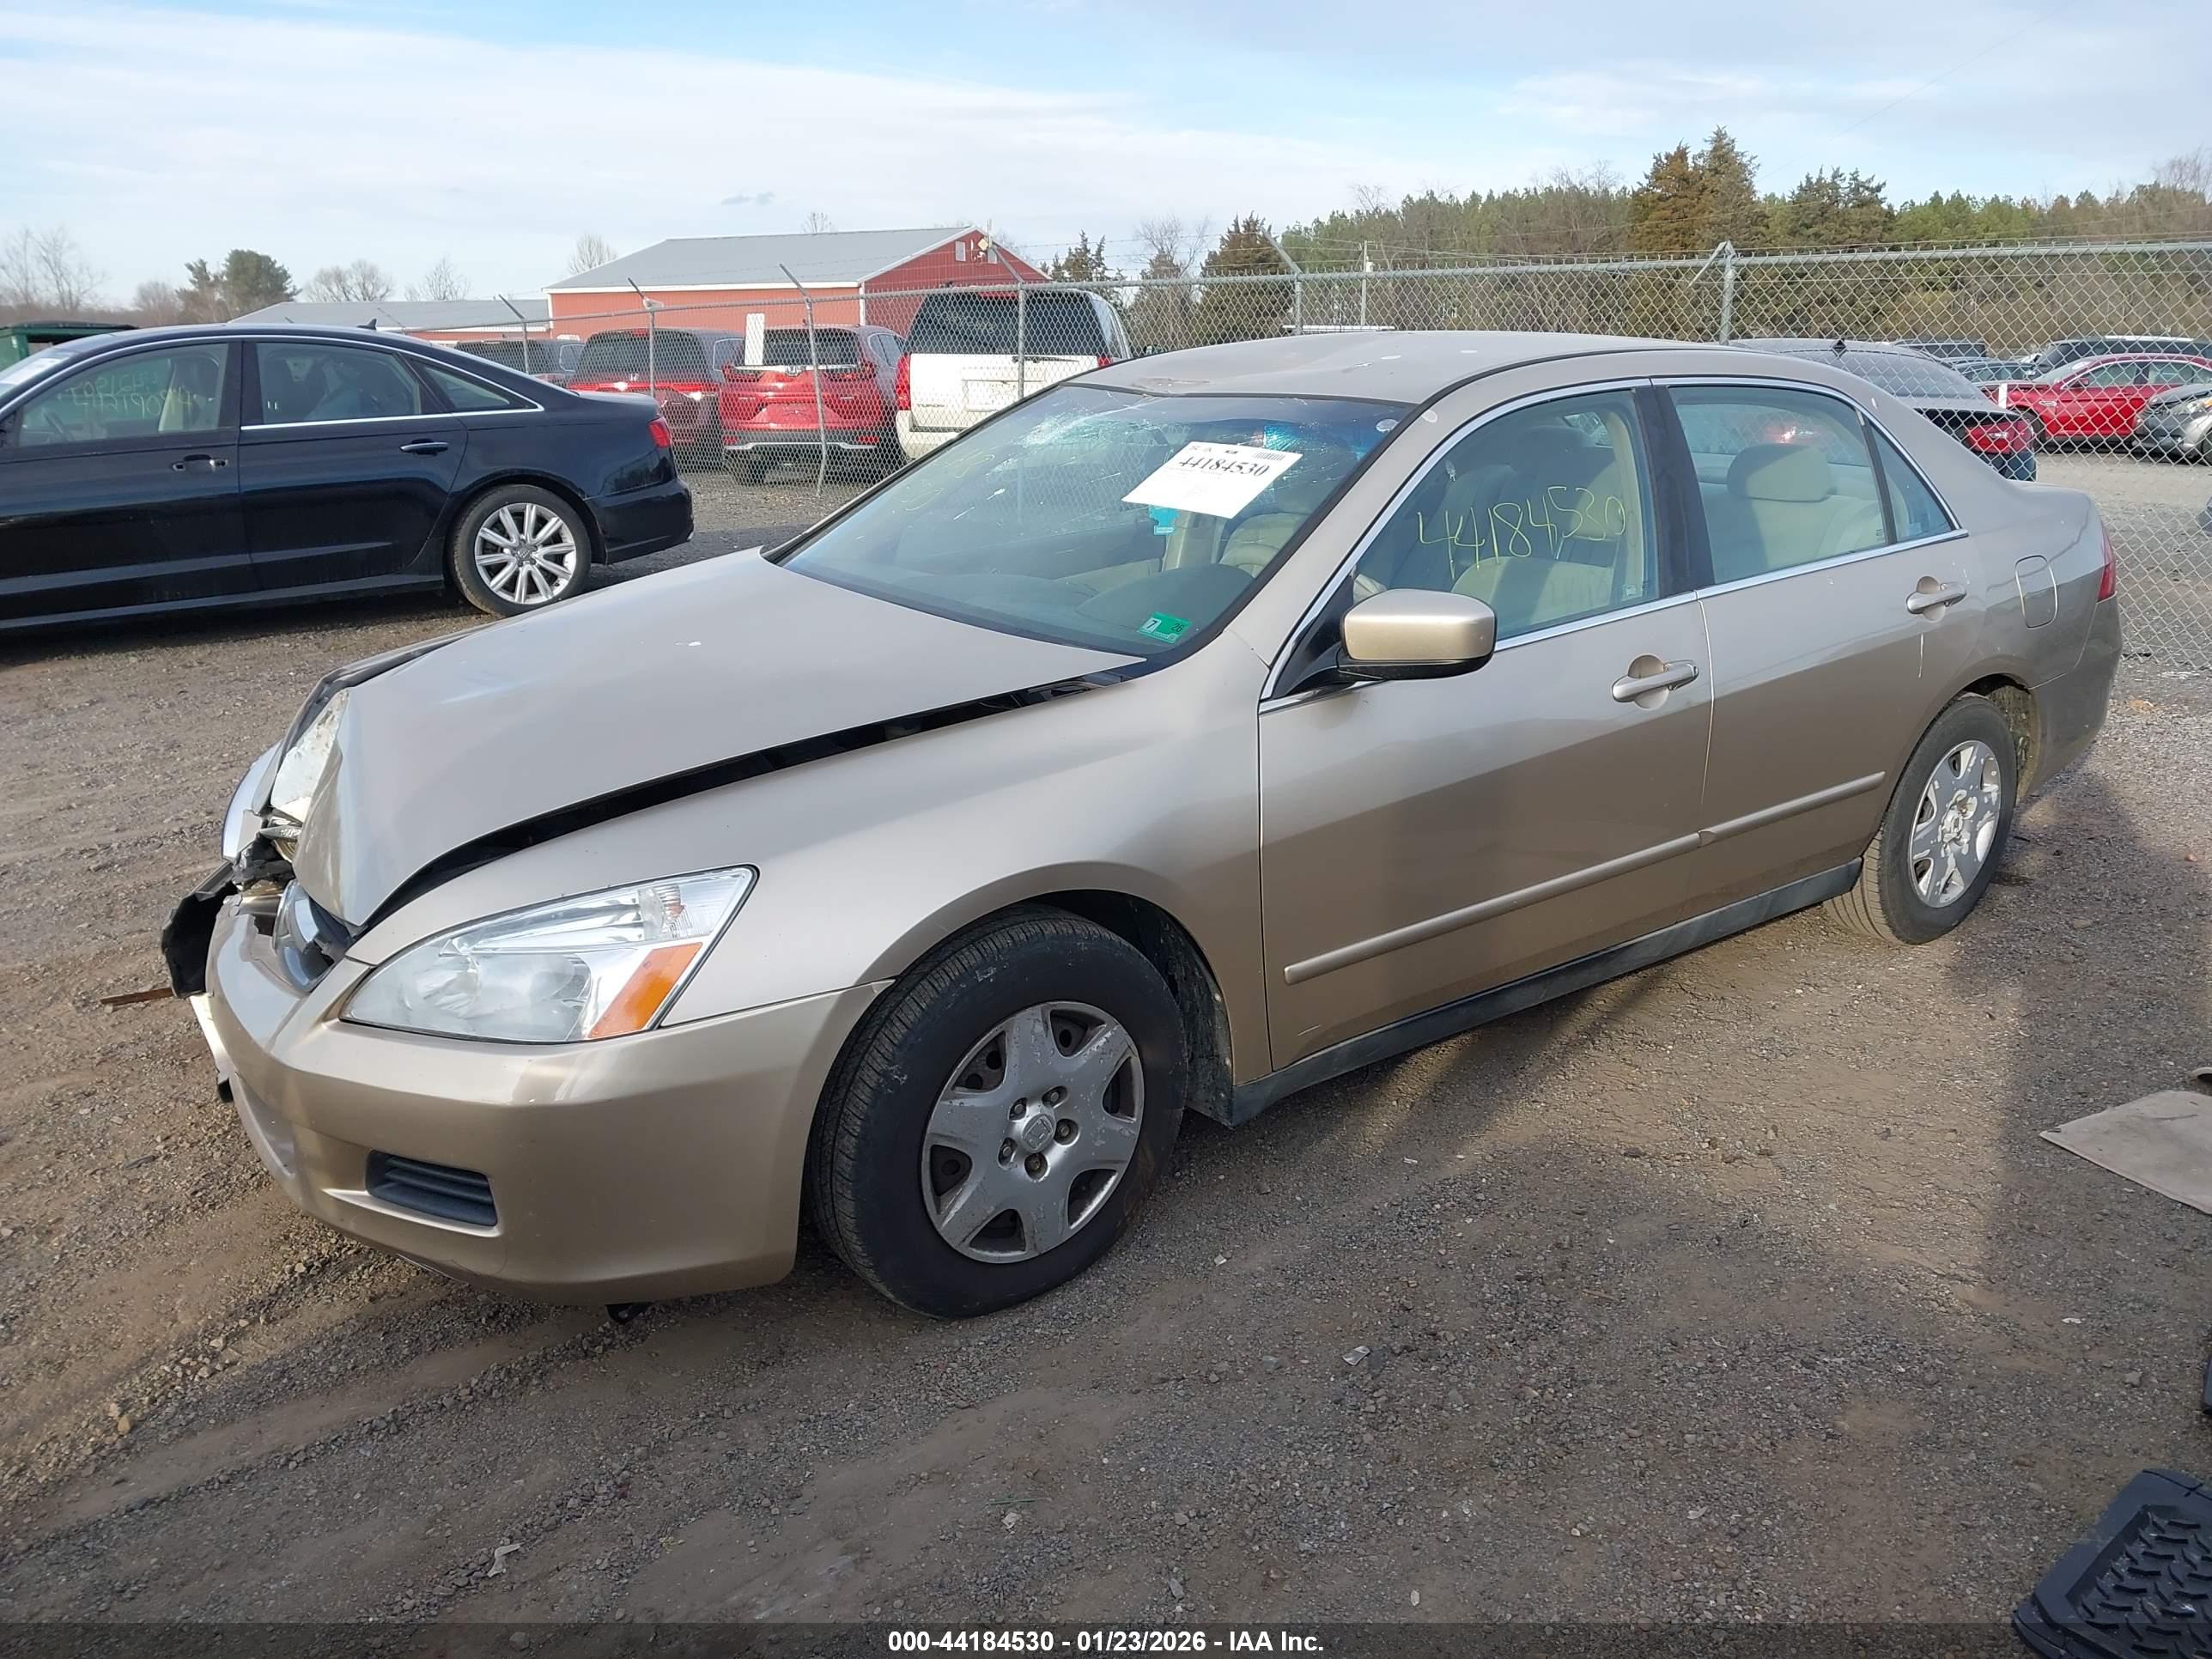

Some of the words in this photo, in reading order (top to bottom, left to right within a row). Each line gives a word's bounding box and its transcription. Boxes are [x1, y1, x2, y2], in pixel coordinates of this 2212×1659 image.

[1179, 455, 1270, 477] 44184530
[1417, 485, 1626, 580] 44184530
[1146, 619, 1158, 629] 7
